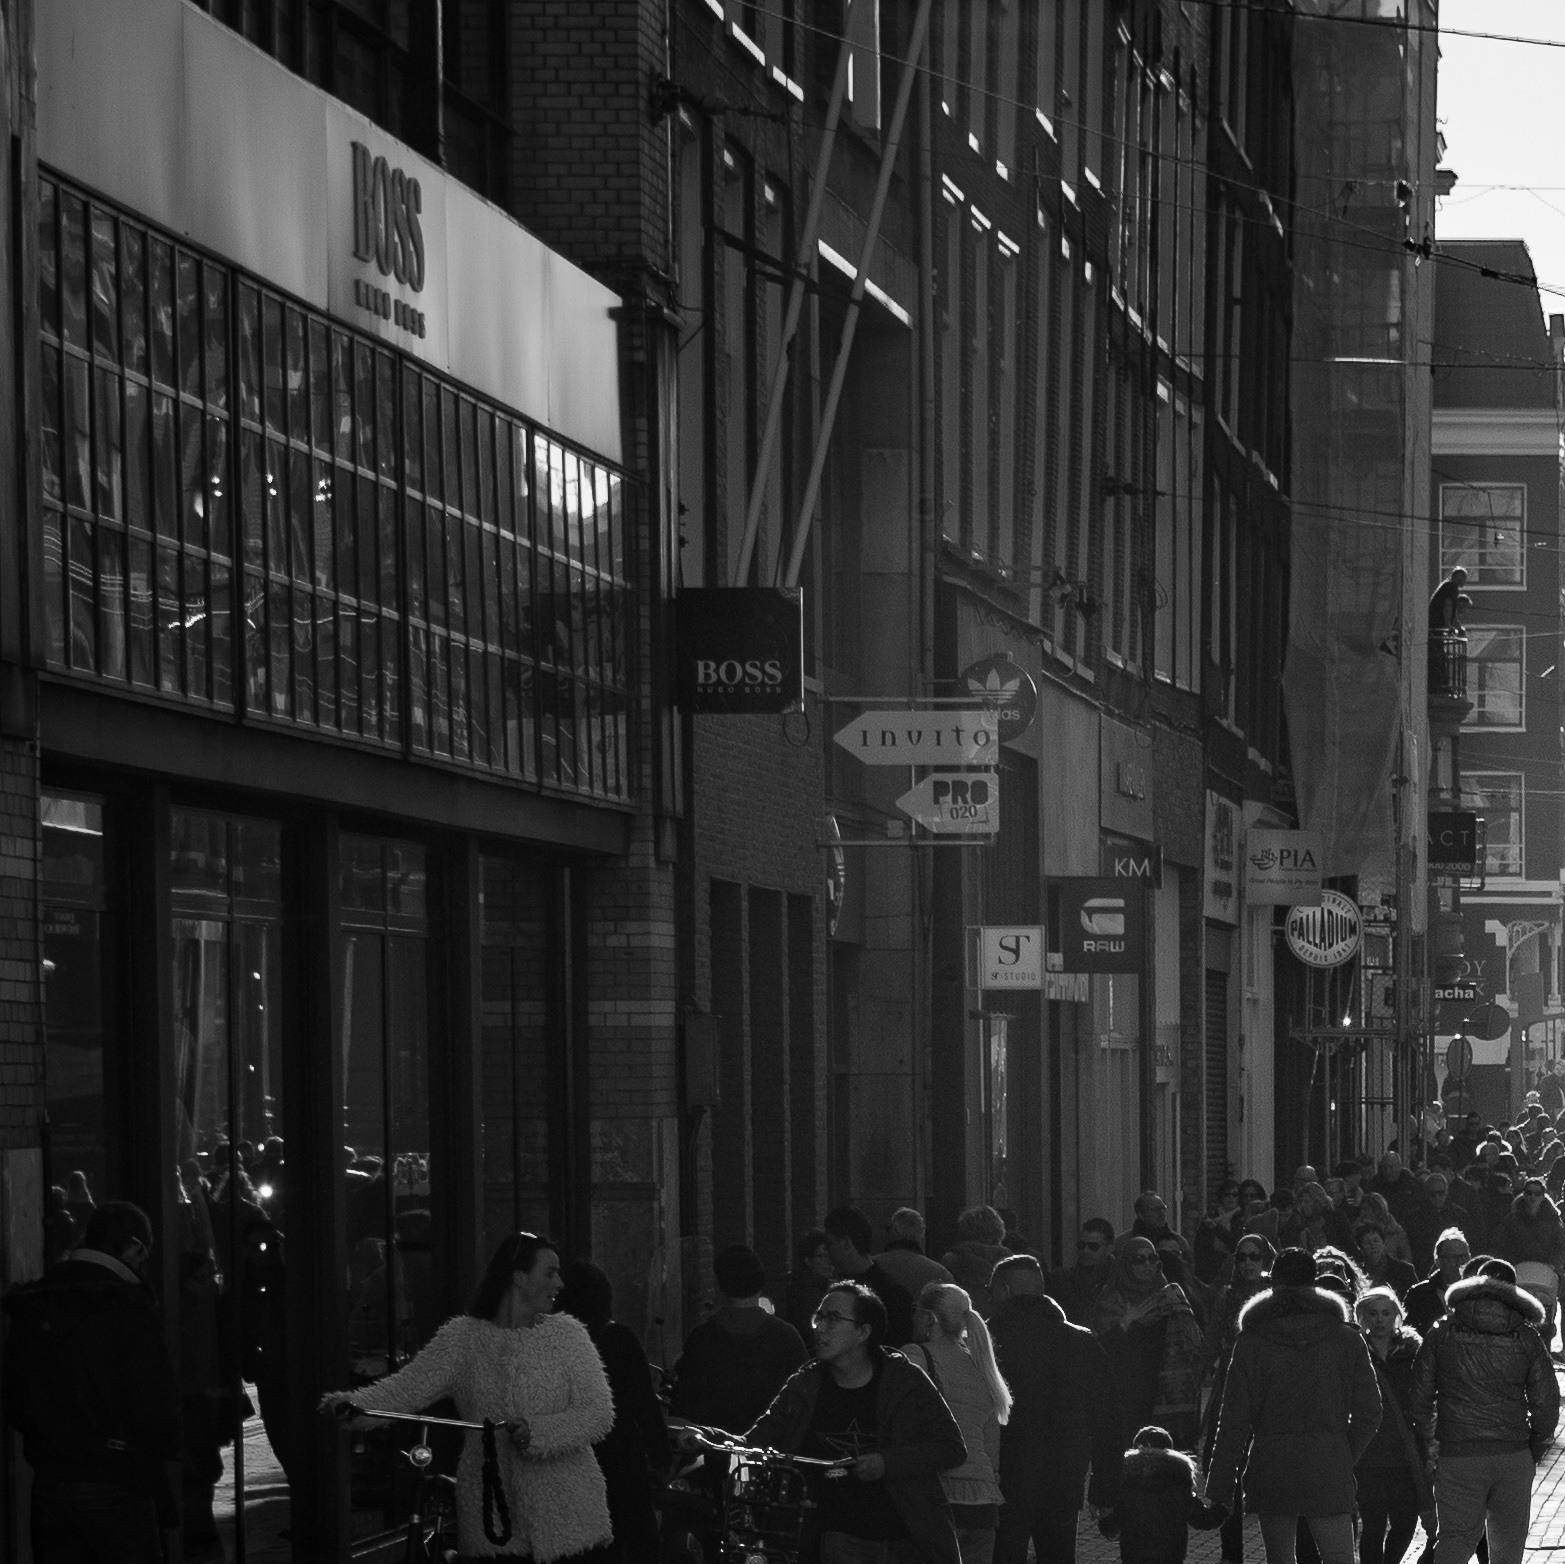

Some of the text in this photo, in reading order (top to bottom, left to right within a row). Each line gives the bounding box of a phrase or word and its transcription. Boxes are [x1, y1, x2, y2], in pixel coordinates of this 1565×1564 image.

[351, 141, 425, 293] BOSS
[697, 660, 782, 684] BOSS
[861, 725, 990, 747] invito
[950, 805, 977, 820] 020
[1115, 857, 1150, 877] KM
[1280, 849, 1317, 868] PIA
[1291, 906, 1357, 951] PALLADIUM
[1083, 941, 1125, 952] RAW
